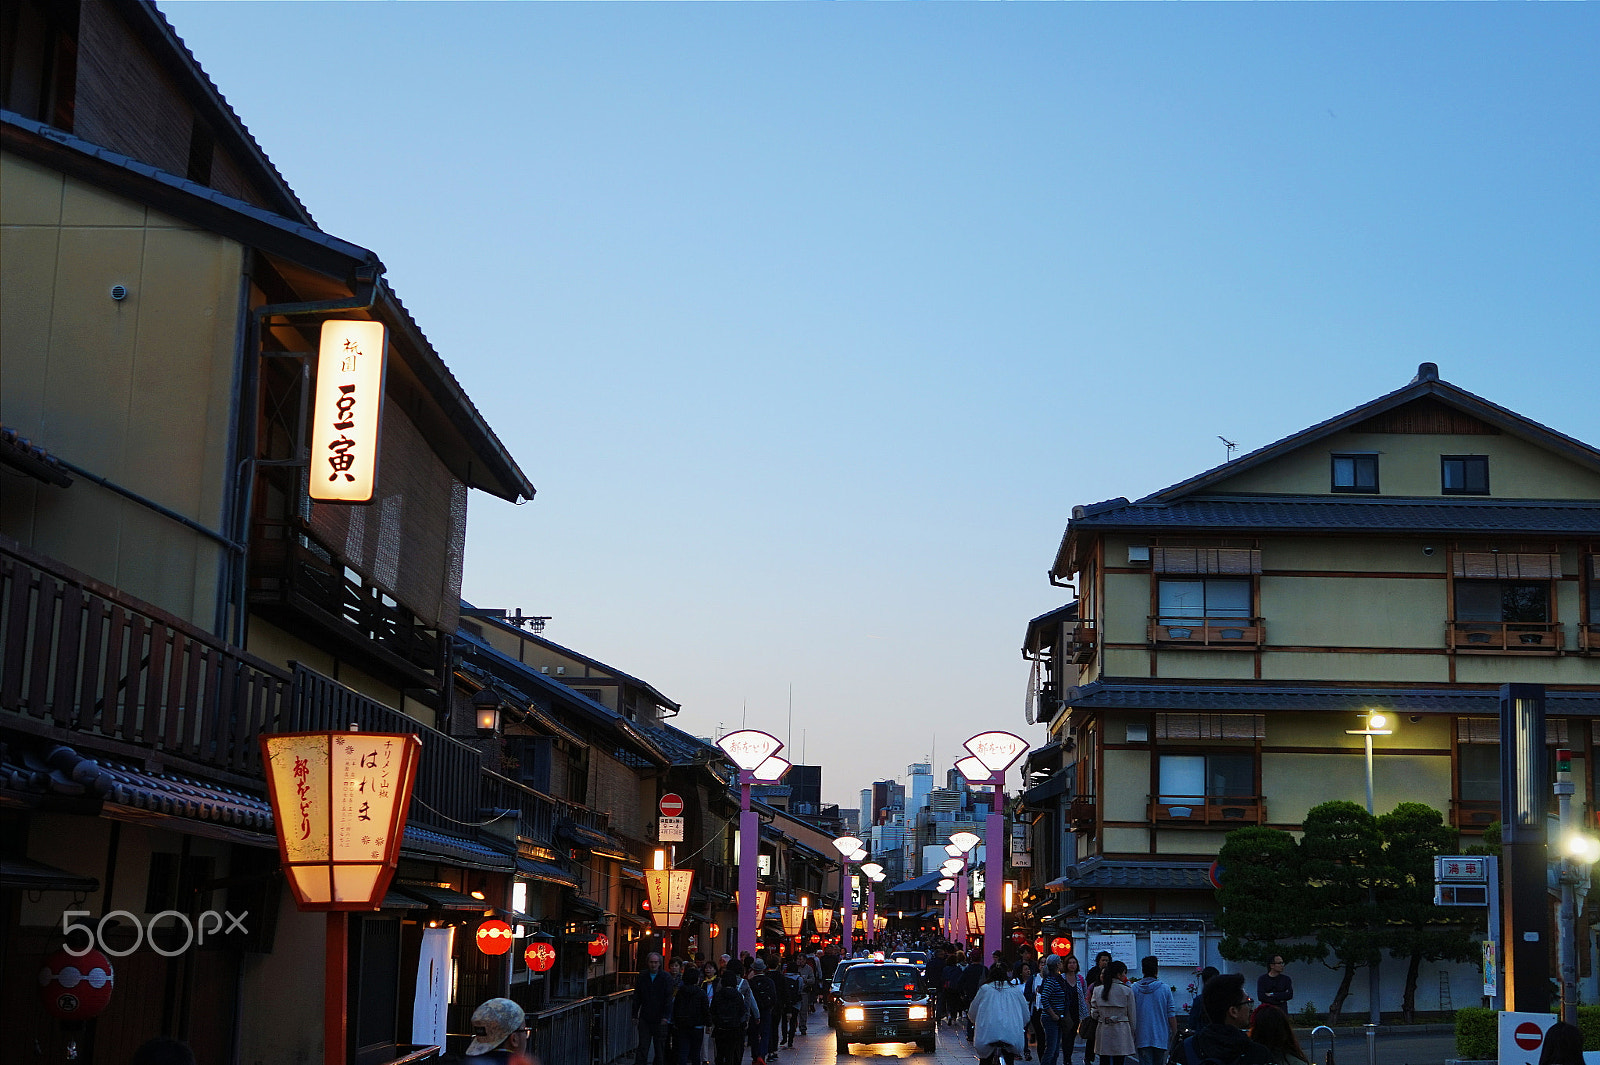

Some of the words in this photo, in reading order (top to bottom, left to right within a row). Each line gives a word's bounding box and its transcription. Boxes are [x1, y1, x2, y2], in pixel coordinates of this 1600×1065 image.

[328, 384, 356, 482] 豆寅
[293, 755, 312, 841] 都をどり
[1448, 863, 1477, 875] 満車
